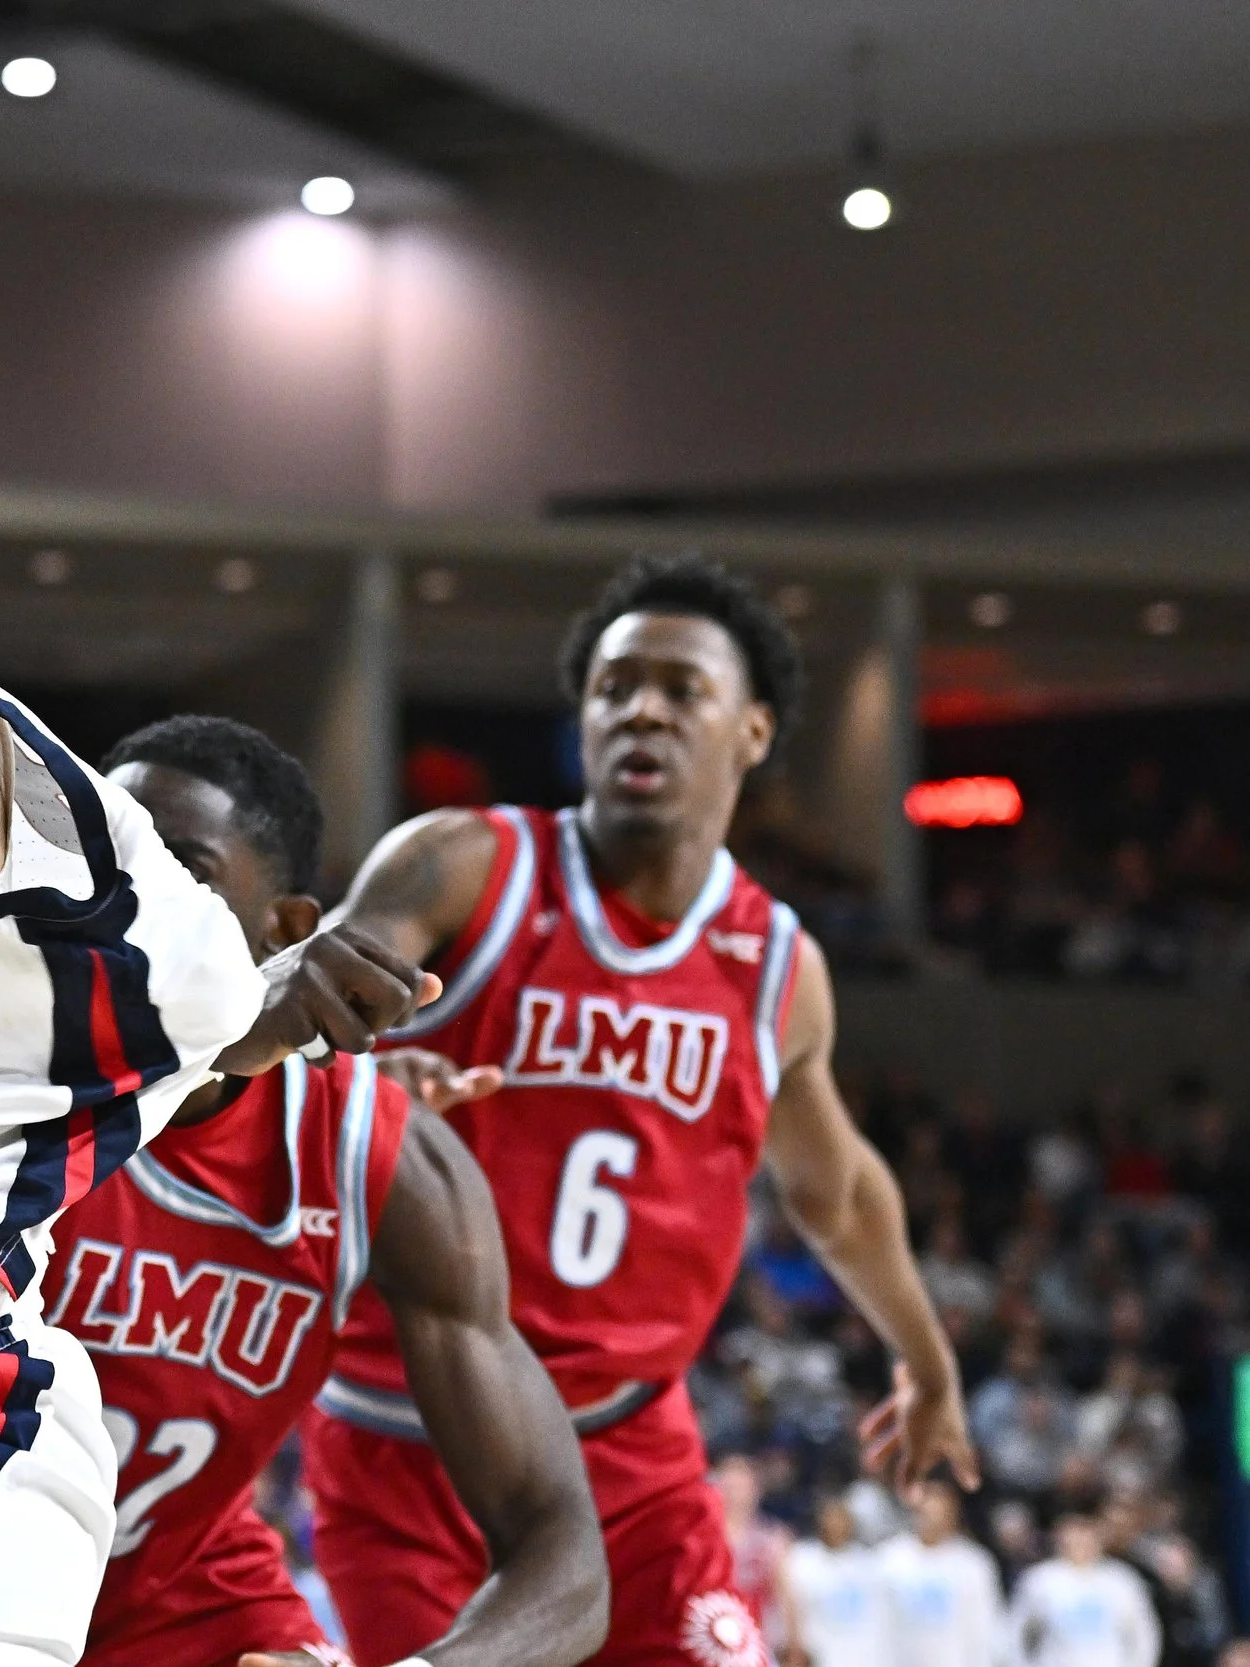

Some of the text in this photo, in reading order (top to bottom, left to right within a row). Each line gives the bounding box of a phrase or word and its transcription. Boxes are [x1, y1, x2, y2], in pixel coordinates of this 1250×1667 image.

[504, 987, 729, 1123] LMU
[551, 1130, 639, 1288] 6
[45, 1237, 324, 1396] LMU
